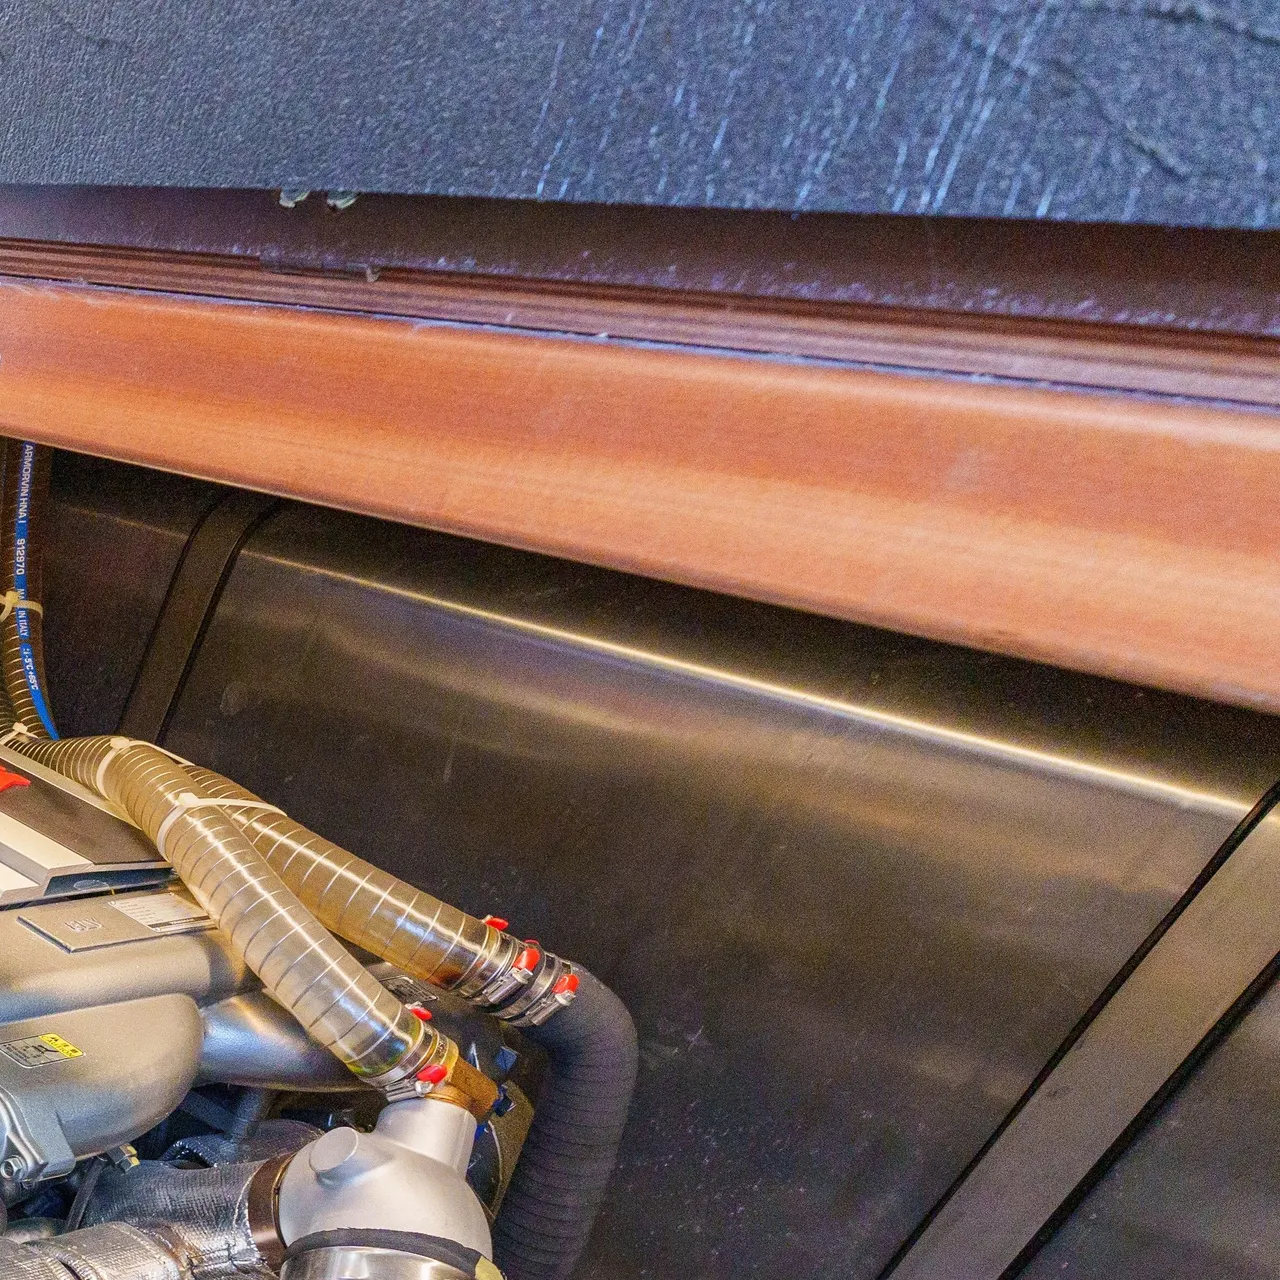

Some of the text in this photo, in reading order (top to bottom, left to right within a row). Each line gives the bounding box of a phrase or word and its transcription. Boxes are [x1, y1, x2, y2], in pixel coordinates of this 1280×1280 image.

[17, 444, 34, 497] ARMORVIN
[17, 499, 28, 517] HNA
[16, 538, 27, 576] 912970
[18, 610, 26, 619] IN
[19, 620, 30, 637] ITALY
